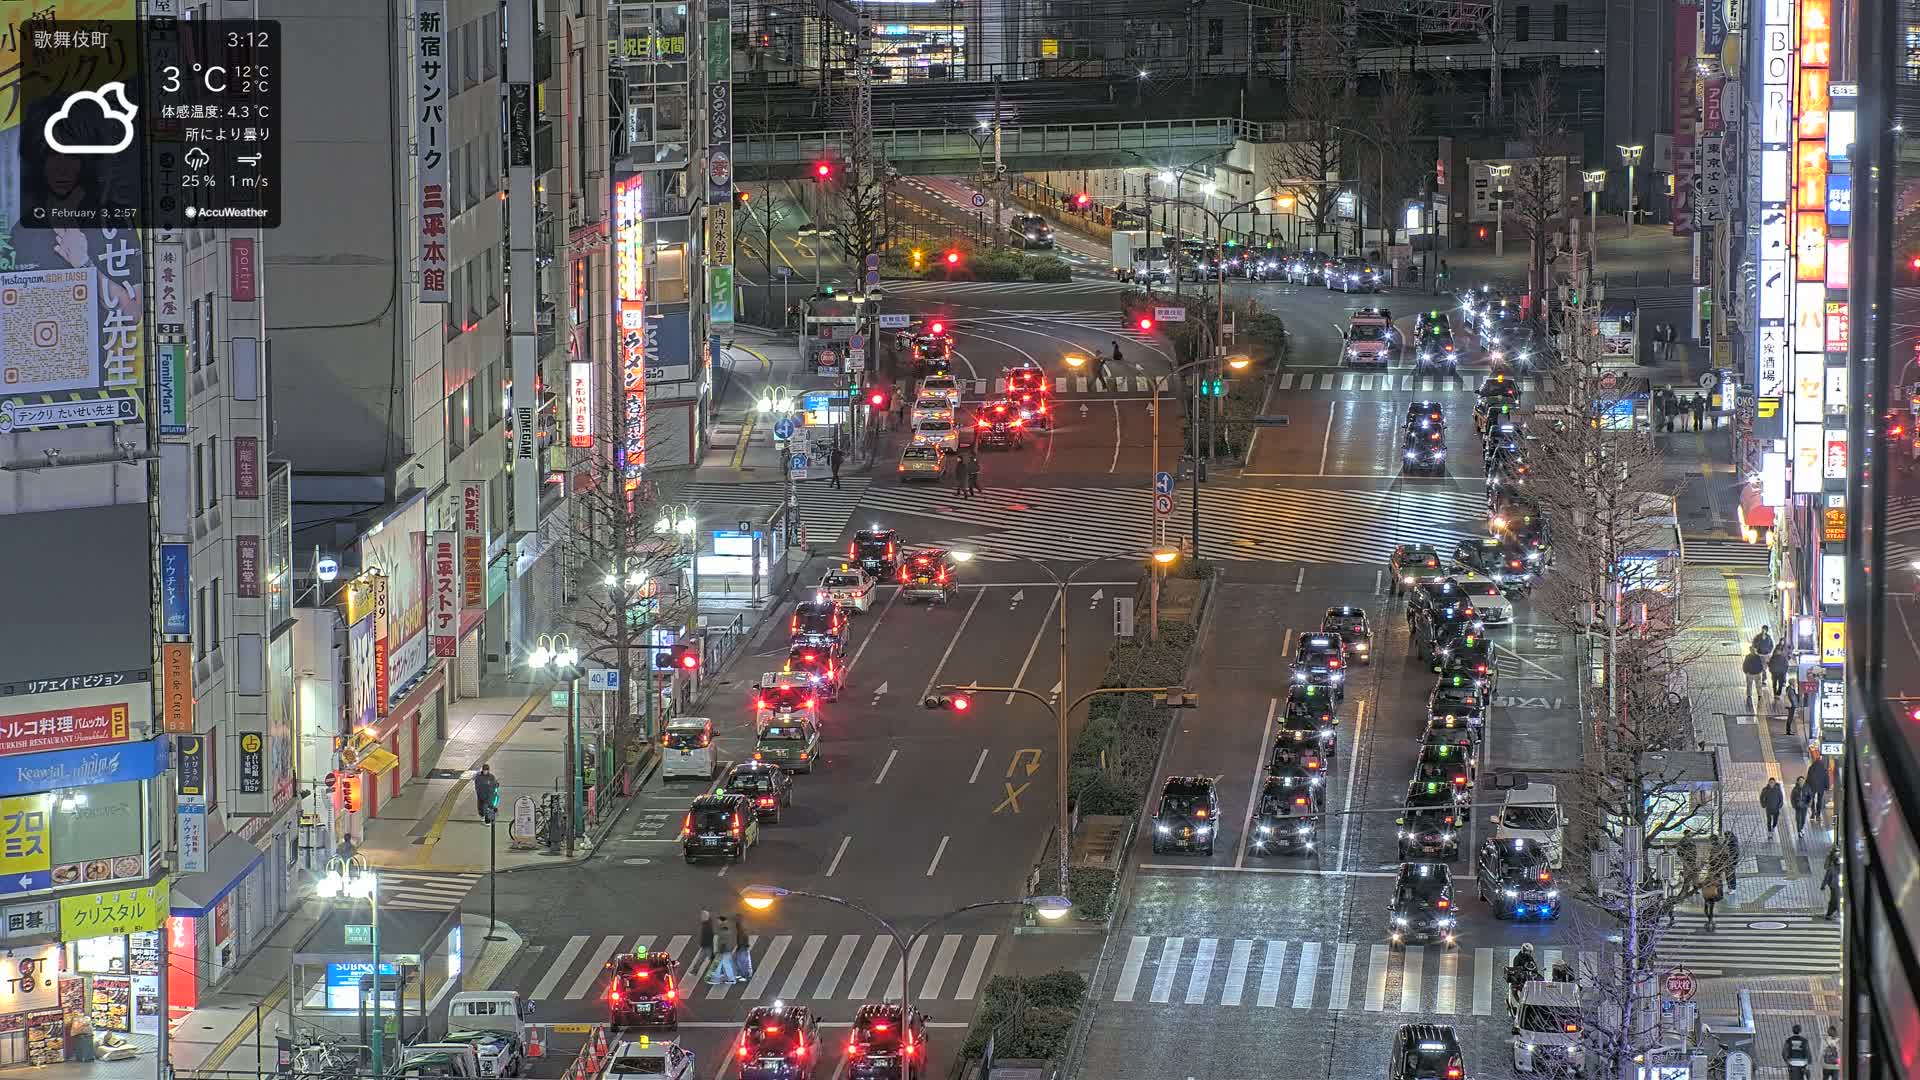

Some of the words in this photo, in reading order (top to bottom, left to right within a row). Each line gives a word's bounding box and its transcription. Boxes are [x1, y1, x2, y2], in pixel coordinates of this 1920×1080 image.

[420, 12, 443, 169] 新宿サンパーク
[1708, 88, 1721, 120] アコム
[423, 184, 446, 292] 三平本館
[715, 207, 727, 263] 肉汁水餃子
[1, 275, 44, 288] Instagram
[713, 275, 728, 314] レイク
[162, 324, 180, 334] 3F
[624, 331, 641, 386] ラーメン
[1763, 332, 1775, 382] 大衆酒場
[161, 353, 173, 414] FamilyMart
[18, 406, 53, 422] テンクリ
[58, 401, 115, 417] たいせい先生
[1831, 404, 1845, 415] 5F
[519, 407, 533, 460] HOMEGAME
[465, 487, 476, 531] GAME
[1831, 497, 1840, 506] 3F
[436, 542, 453, 628] 三平ストア
[378, 581, 386, 620] 389
[173, 649, 181, 677] CAFE
[28, 677, 80, 694] リアエイド
[83, 674, 124, 688] ビジョン
[173, 680, 182, 690] de
[173, 693, 182, 720] CRIE
[113, 711, 123, 736] 5F
[170, 722, 185, 731] B2
[29, 734, 74, 748] RESTAURANT
[246, 735, 258, 750] 占
[3, 811, 44, 835] プロ
[5, 838, 44, 858] ミス
[8, 910, 43, 932] 囲碁
[74, 902, 146, 926] クリスタル
[336, 963, 388, 971] SUBNAE
